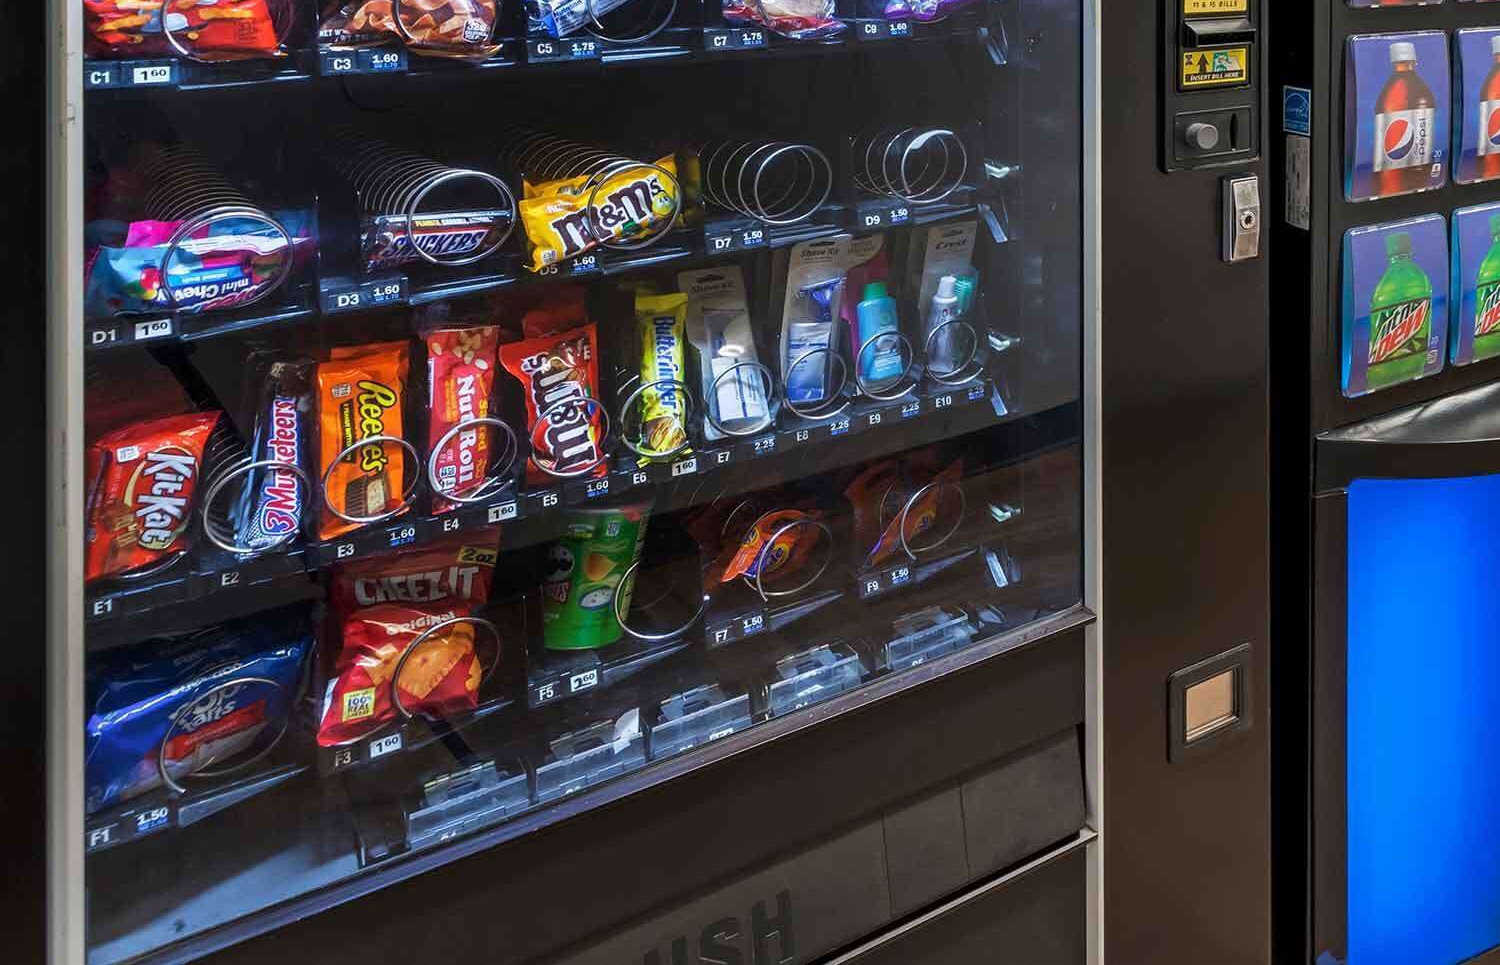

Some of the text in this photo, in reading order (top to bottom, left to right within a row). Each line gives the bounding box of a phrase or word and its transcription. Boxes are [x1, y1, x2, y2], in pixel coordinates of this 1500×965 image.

[1219, 0, 1238, 8] BILLS
[864, 22, 907, 34] C9 1.60
[713, 32, 763, 47] C7 1.75
[537, 42, 595, 55] C5 1.75
[333, 53, 399, 71] C3 1.60
[90, 71, 111, 84] C1
[1190, 74, 1211, 82] INSERT
[865, 208, 908, 226] D9 1.50
[391, 229, 489, 256] SNICKERS
[714, 230, 763, 249] D7 1.50
[936, 240, 967, 251] Crest
[572, 255, 595, 267] 1.60
[221, 278, 249, 294] mini
[337, 284, 400, 307] D3 1.60
[92, 329, 116, 344] D1
[652, 316, 678, 411] Butterfinger
[935, 395, 952, 408] E10
[869, 402, 920, 425] E9 2.25
[356, 379, 397, 472] Reese's
[457, 374, 477, 484] Nut Roll
[830, 420, 849, 431] 2.25
[717, 438, 775, 463] E7 2.25
[262, 396, 298, 536] 3 Musketeers
[633, 471, 647, 485] E6
[542, 480, 609, 507] E5 1.60
[443, 519, 460, 532] E4
[337, 527, 416, 558] E3 1.60
[220, 572, 240, 586] E2
[866, 568, 909, 593] F9 1.50
[93, 598, 113, 615] E1
[715, 616, 763, 642] F7 1.50
[539, 687, 554, 700] F5
[335, 750, 352, 767] F3
[90, 807, 169, 846] F1 1.50
